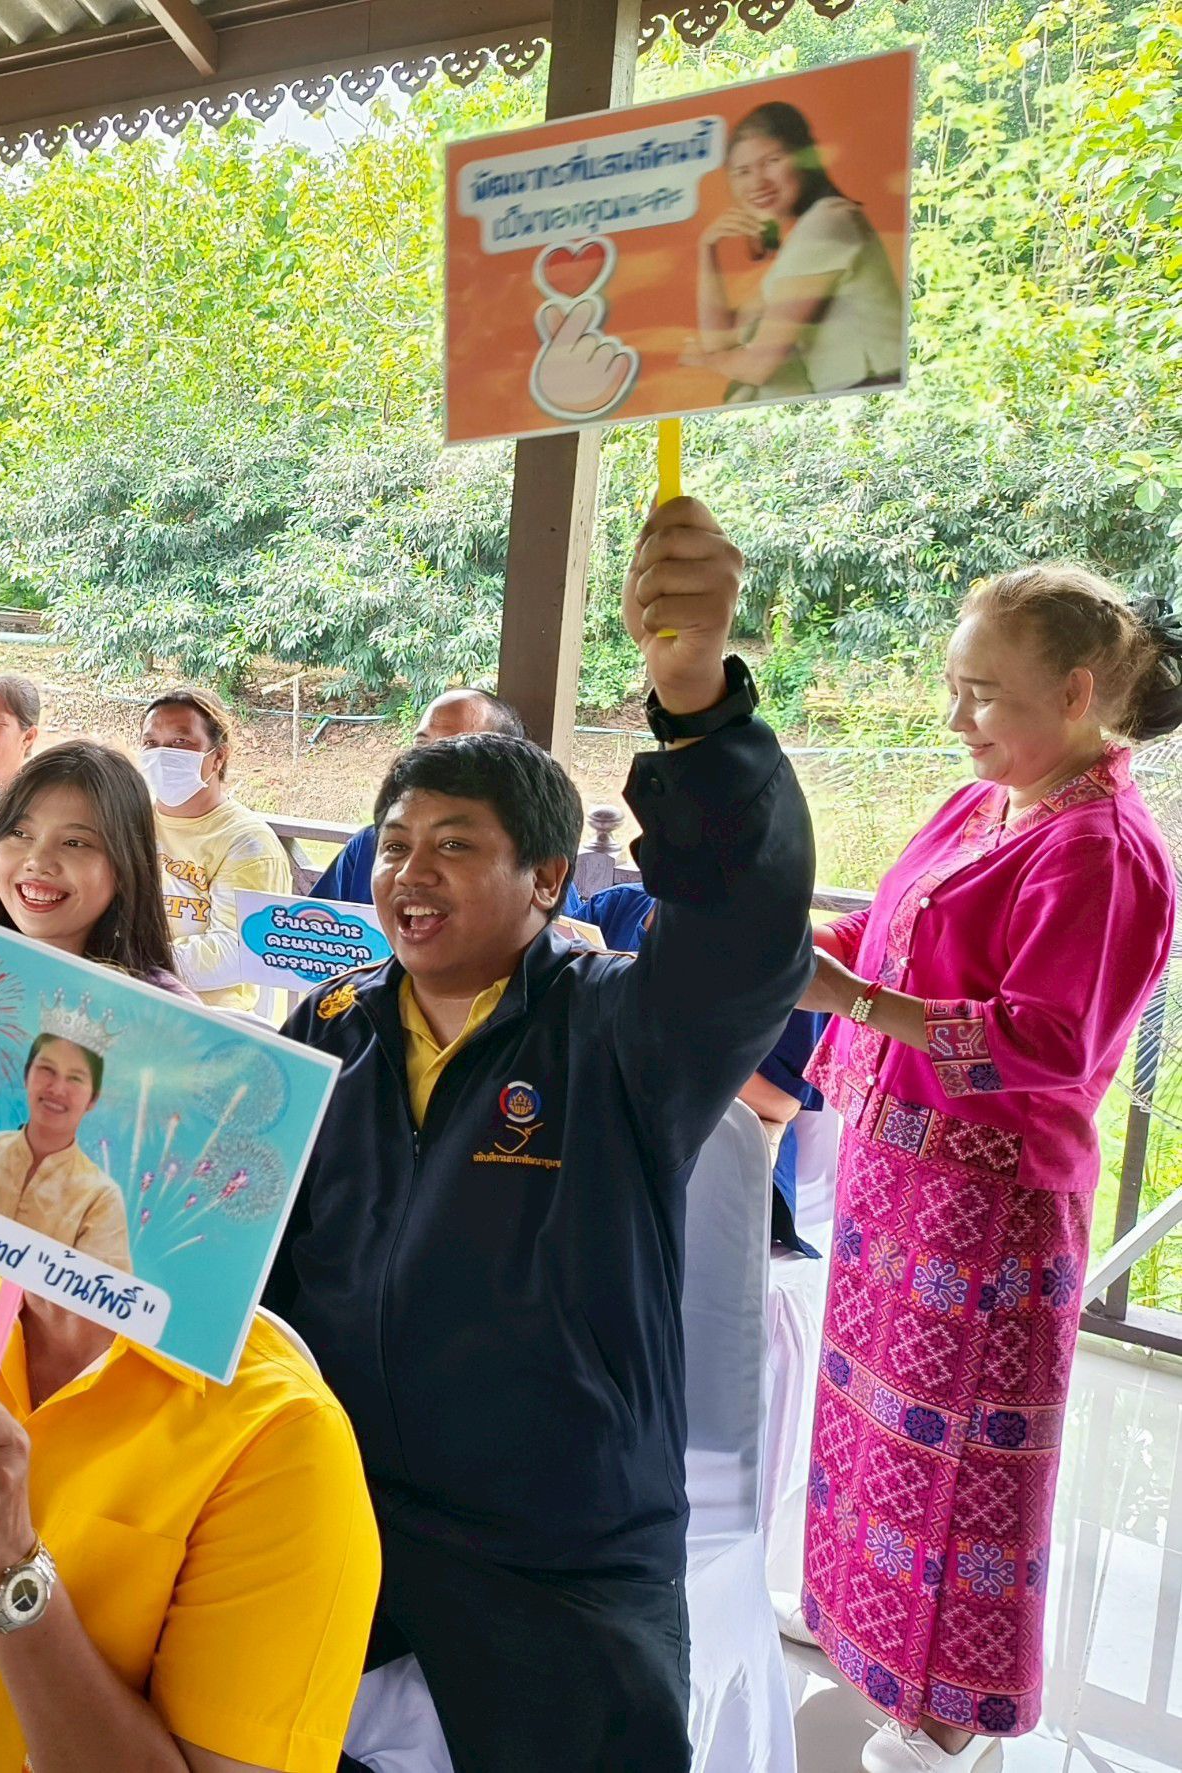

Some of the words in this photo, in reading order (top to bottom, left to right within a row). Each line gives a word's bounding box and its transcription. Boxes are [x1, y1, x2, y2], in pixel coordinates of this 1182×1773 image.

[162, 894, 212, 923] TY
[271, 907, 363, 939] รับเฉพาะ
[265, 934, 373, 961] คะแนนจาก
